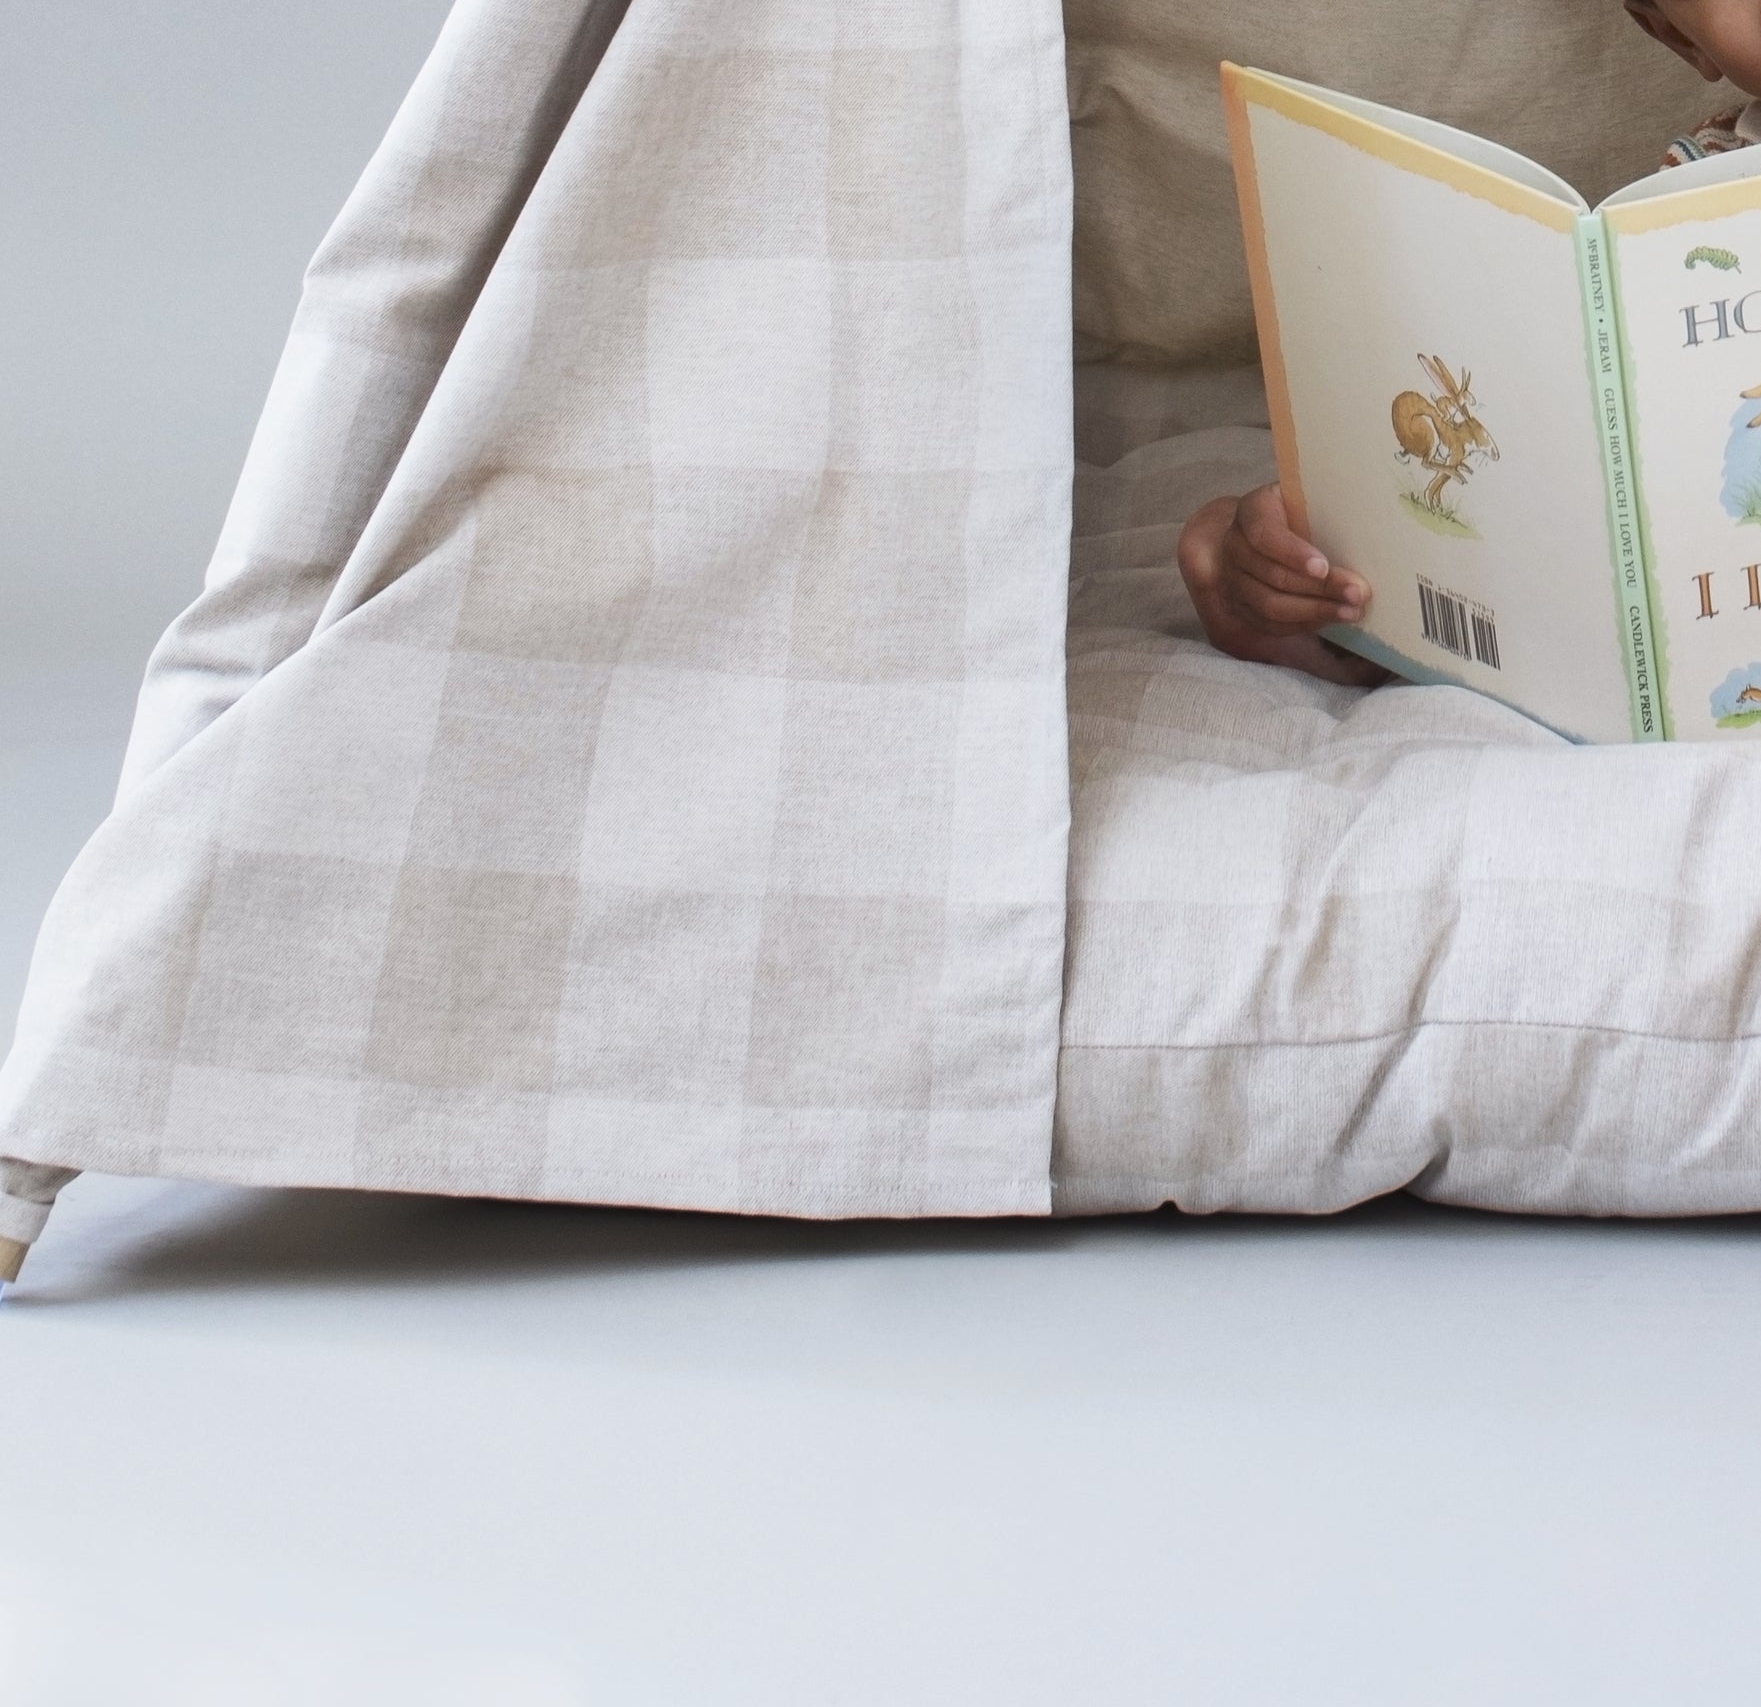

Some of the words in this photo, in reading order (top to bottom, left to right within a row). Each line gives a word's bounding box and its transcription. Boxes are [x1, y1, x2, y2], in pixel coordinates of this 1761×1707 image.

[1597, 328, 1612, 373] JERAM
[1603, 387, 1619, 430] GUESS
[1609, 435, 1623, 467] HOW
[1613, 469, 1628, 509] MUCH
[1619, 522, 1634, 557] LOVE
[1624, 560, 1638, 588] YOU
[1691, 571, 1720, 621] I
[1629, 604, 1649, 692] CANDLEWICK
[1640, 693, 1654, 734] PRESS
